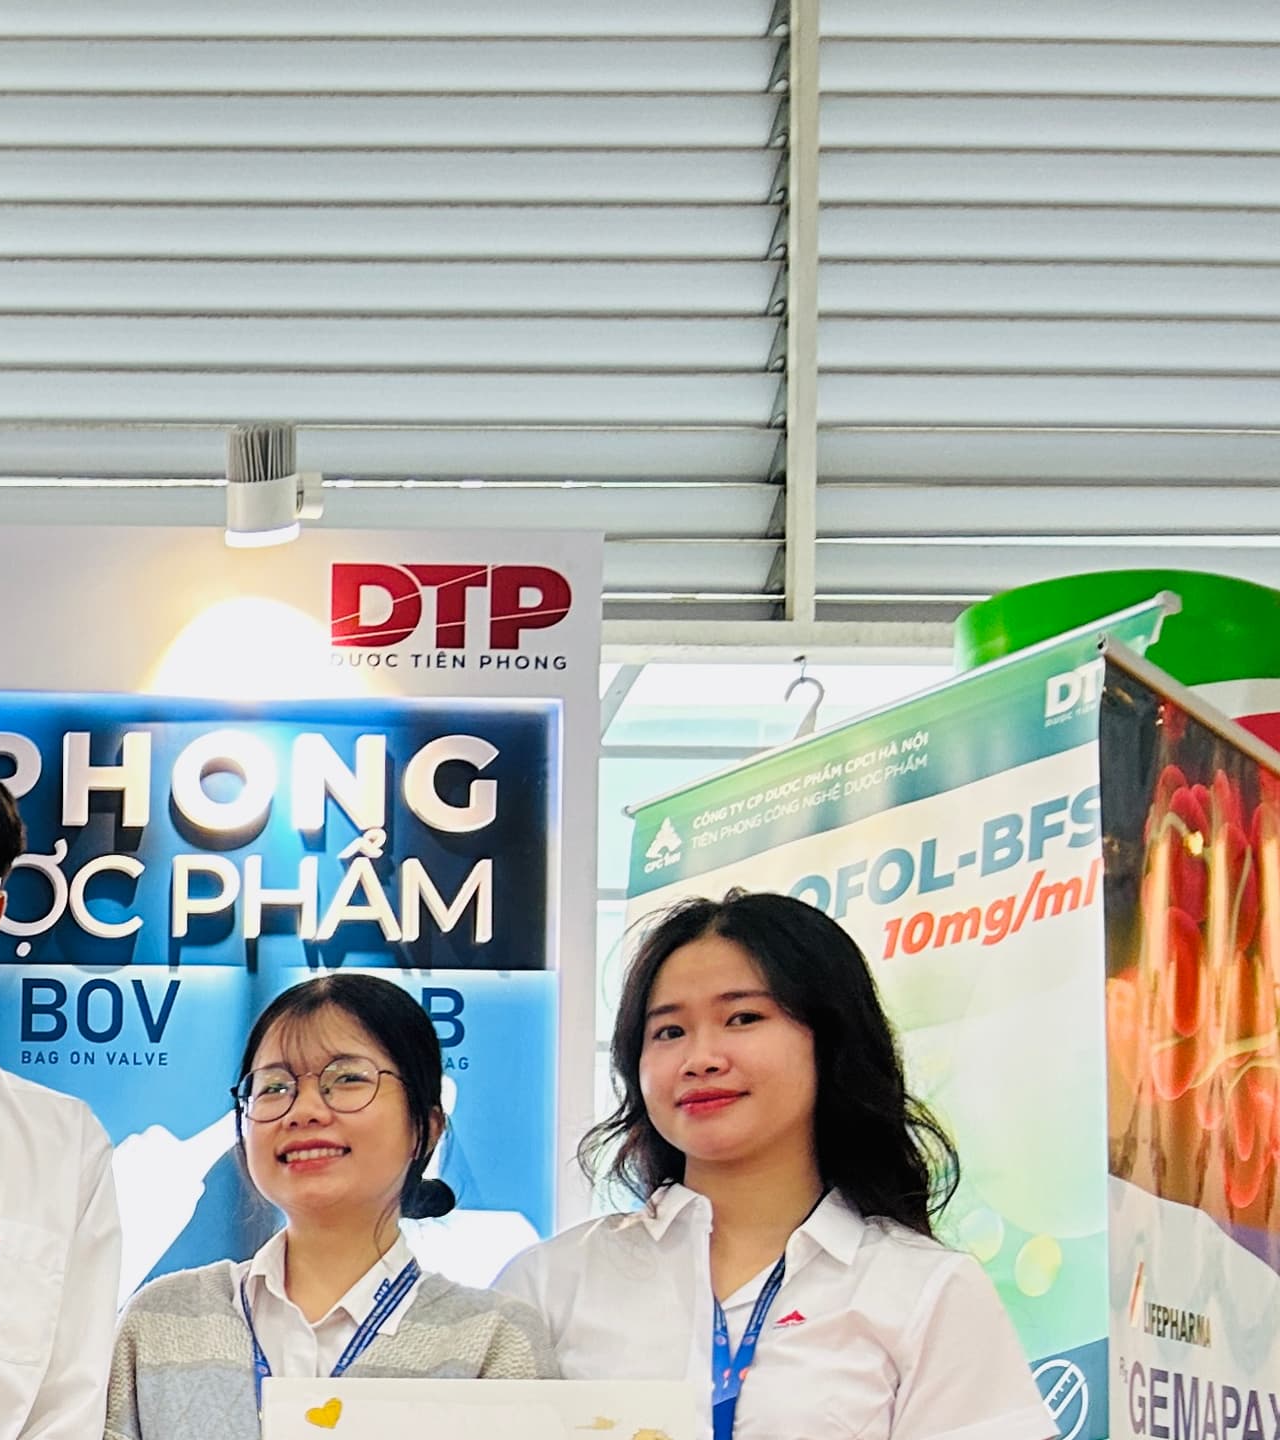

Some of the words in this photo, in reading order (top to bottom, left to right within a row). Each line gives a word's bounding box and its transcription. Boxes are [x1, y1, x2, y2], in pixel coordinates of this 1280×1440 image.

[330, 563, 572, 650] DTP
[413, 650, 466, 670] TIÊN
[479, 655, 568, 671] PHONG
[1044, 655, 1106, 719] DT
[720, 816, 762, 841] PHONG
[171, 827, 494, 944] PHẨM
[883, 857, 1105, 962] 10mg/ml
[20, 978, 181, 1044] BOV
[21, 1051, 62, 1065] BAG
[70, 1052, 97, 1065] ON
[106, 1052, 169, 1067] VALVE
